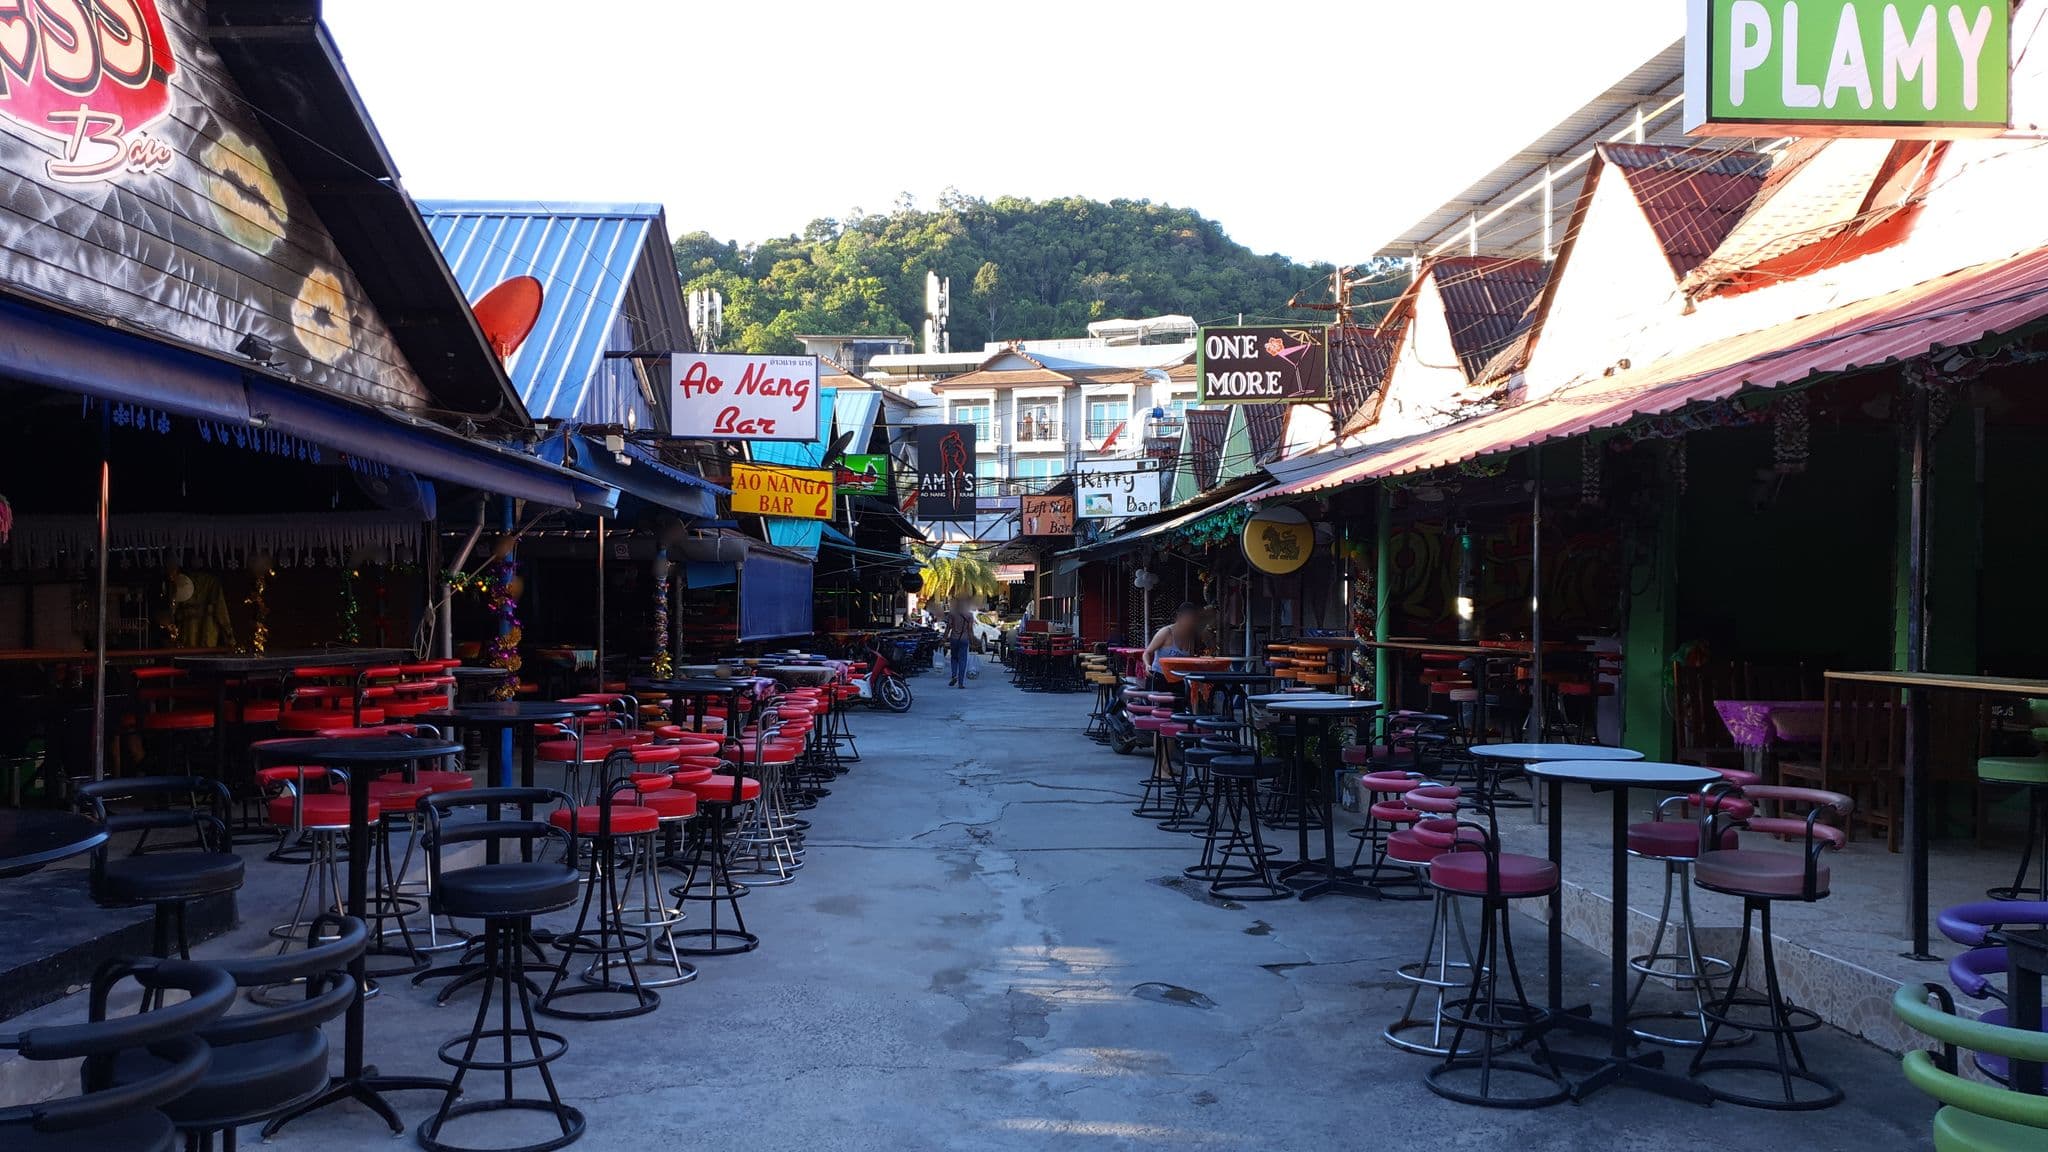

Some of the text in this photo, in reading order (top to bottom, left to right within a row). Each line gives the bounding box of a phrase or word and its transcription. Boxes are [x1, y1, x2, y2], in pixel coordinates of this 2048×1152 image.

[1729, 0, 1992, 111] PLAMY
[47, 104, 172, 175] Bar
[1205, 335, 1259, 360] ONE
[679, 361, 810, 412] Ao Nang
[1206, 371, 1283, 396] MORE
[712, 406, 776, 434] Bar
[736, 472, 761, 491] AO
[767, 475, 814, 495] NANG
[1080, 468, 1135, 493] Kitty
[759, 480, 829, 517] BAR 2
[1025, 500, 1072, 517] Left Side
[1126, 495, 1158, 513] Bar
[1048, 520, 1071, 534] Bar
